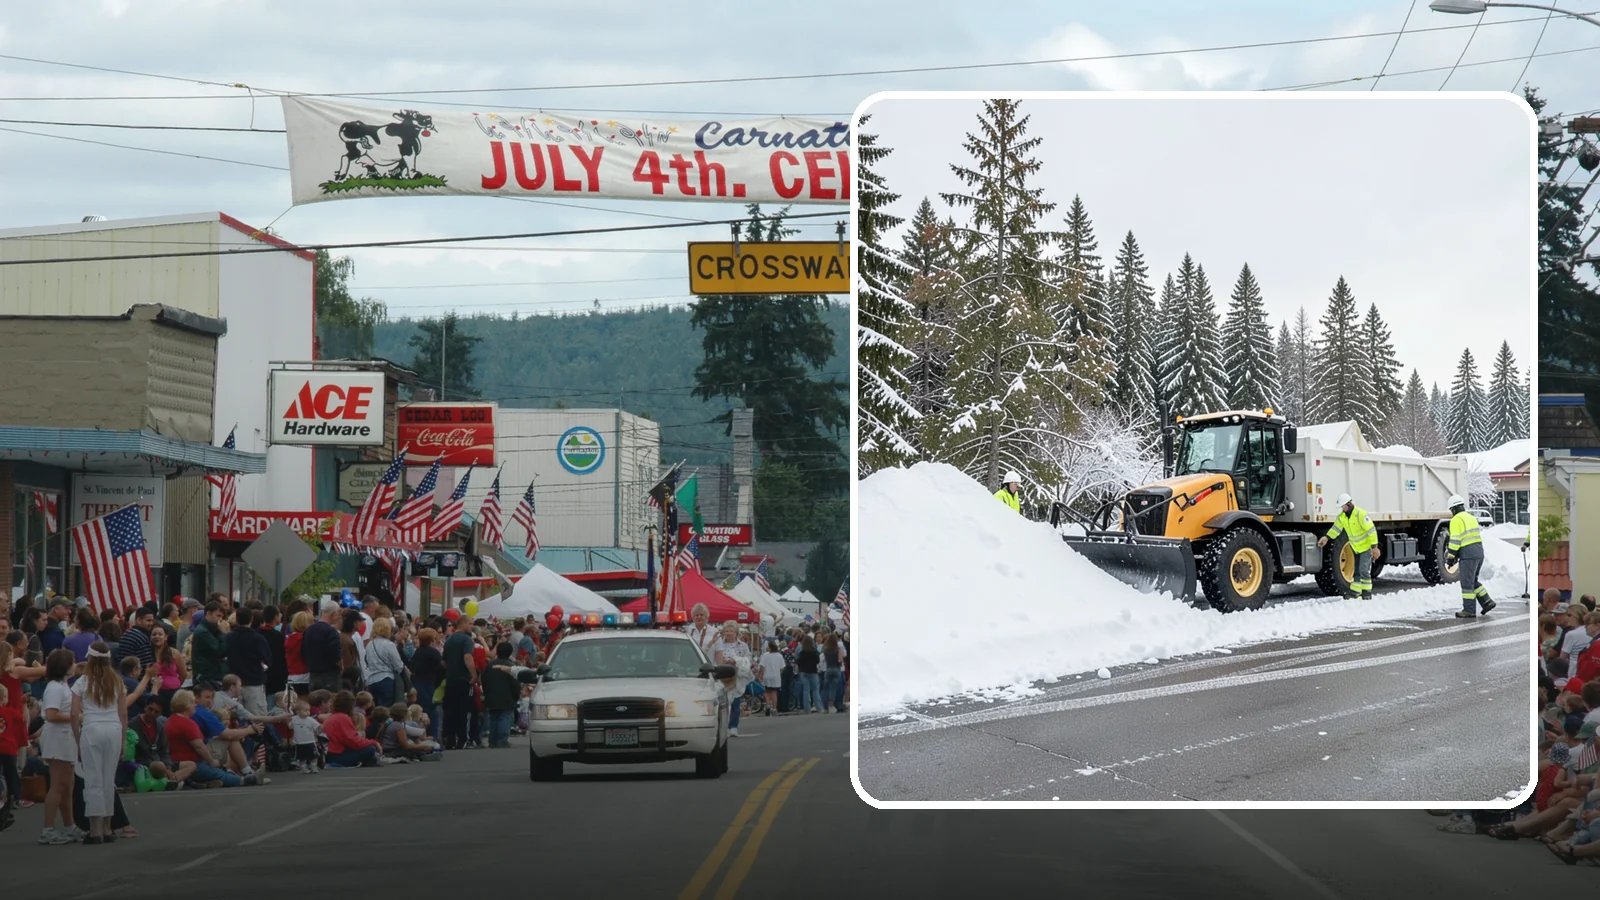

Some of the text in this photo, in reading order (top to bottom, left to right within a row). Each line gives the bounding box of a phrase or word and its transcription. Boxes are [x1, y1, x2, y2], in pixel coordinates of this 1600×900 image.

[481, 141, 605, 191] JULY
[632, 150, 746, 198] 4th.
[697, 254, 850, 280] CROSSWA
[282, 380, 374, 420] ACE
[405, 409, 453, 422] CEDAR
[283, 421, 371, 436] Hardware
[416, 428, 477, 447] Coca-Cola
[95, 485, 124, 495] Vincent
[126, 486, 136, 495] de
[137, 486, 155, 495] Paul
[212, 516, 331, 536] HARDARE
[688, 526, 741, 535] CRNATION
[699, 535, 730, 543] GLASS
